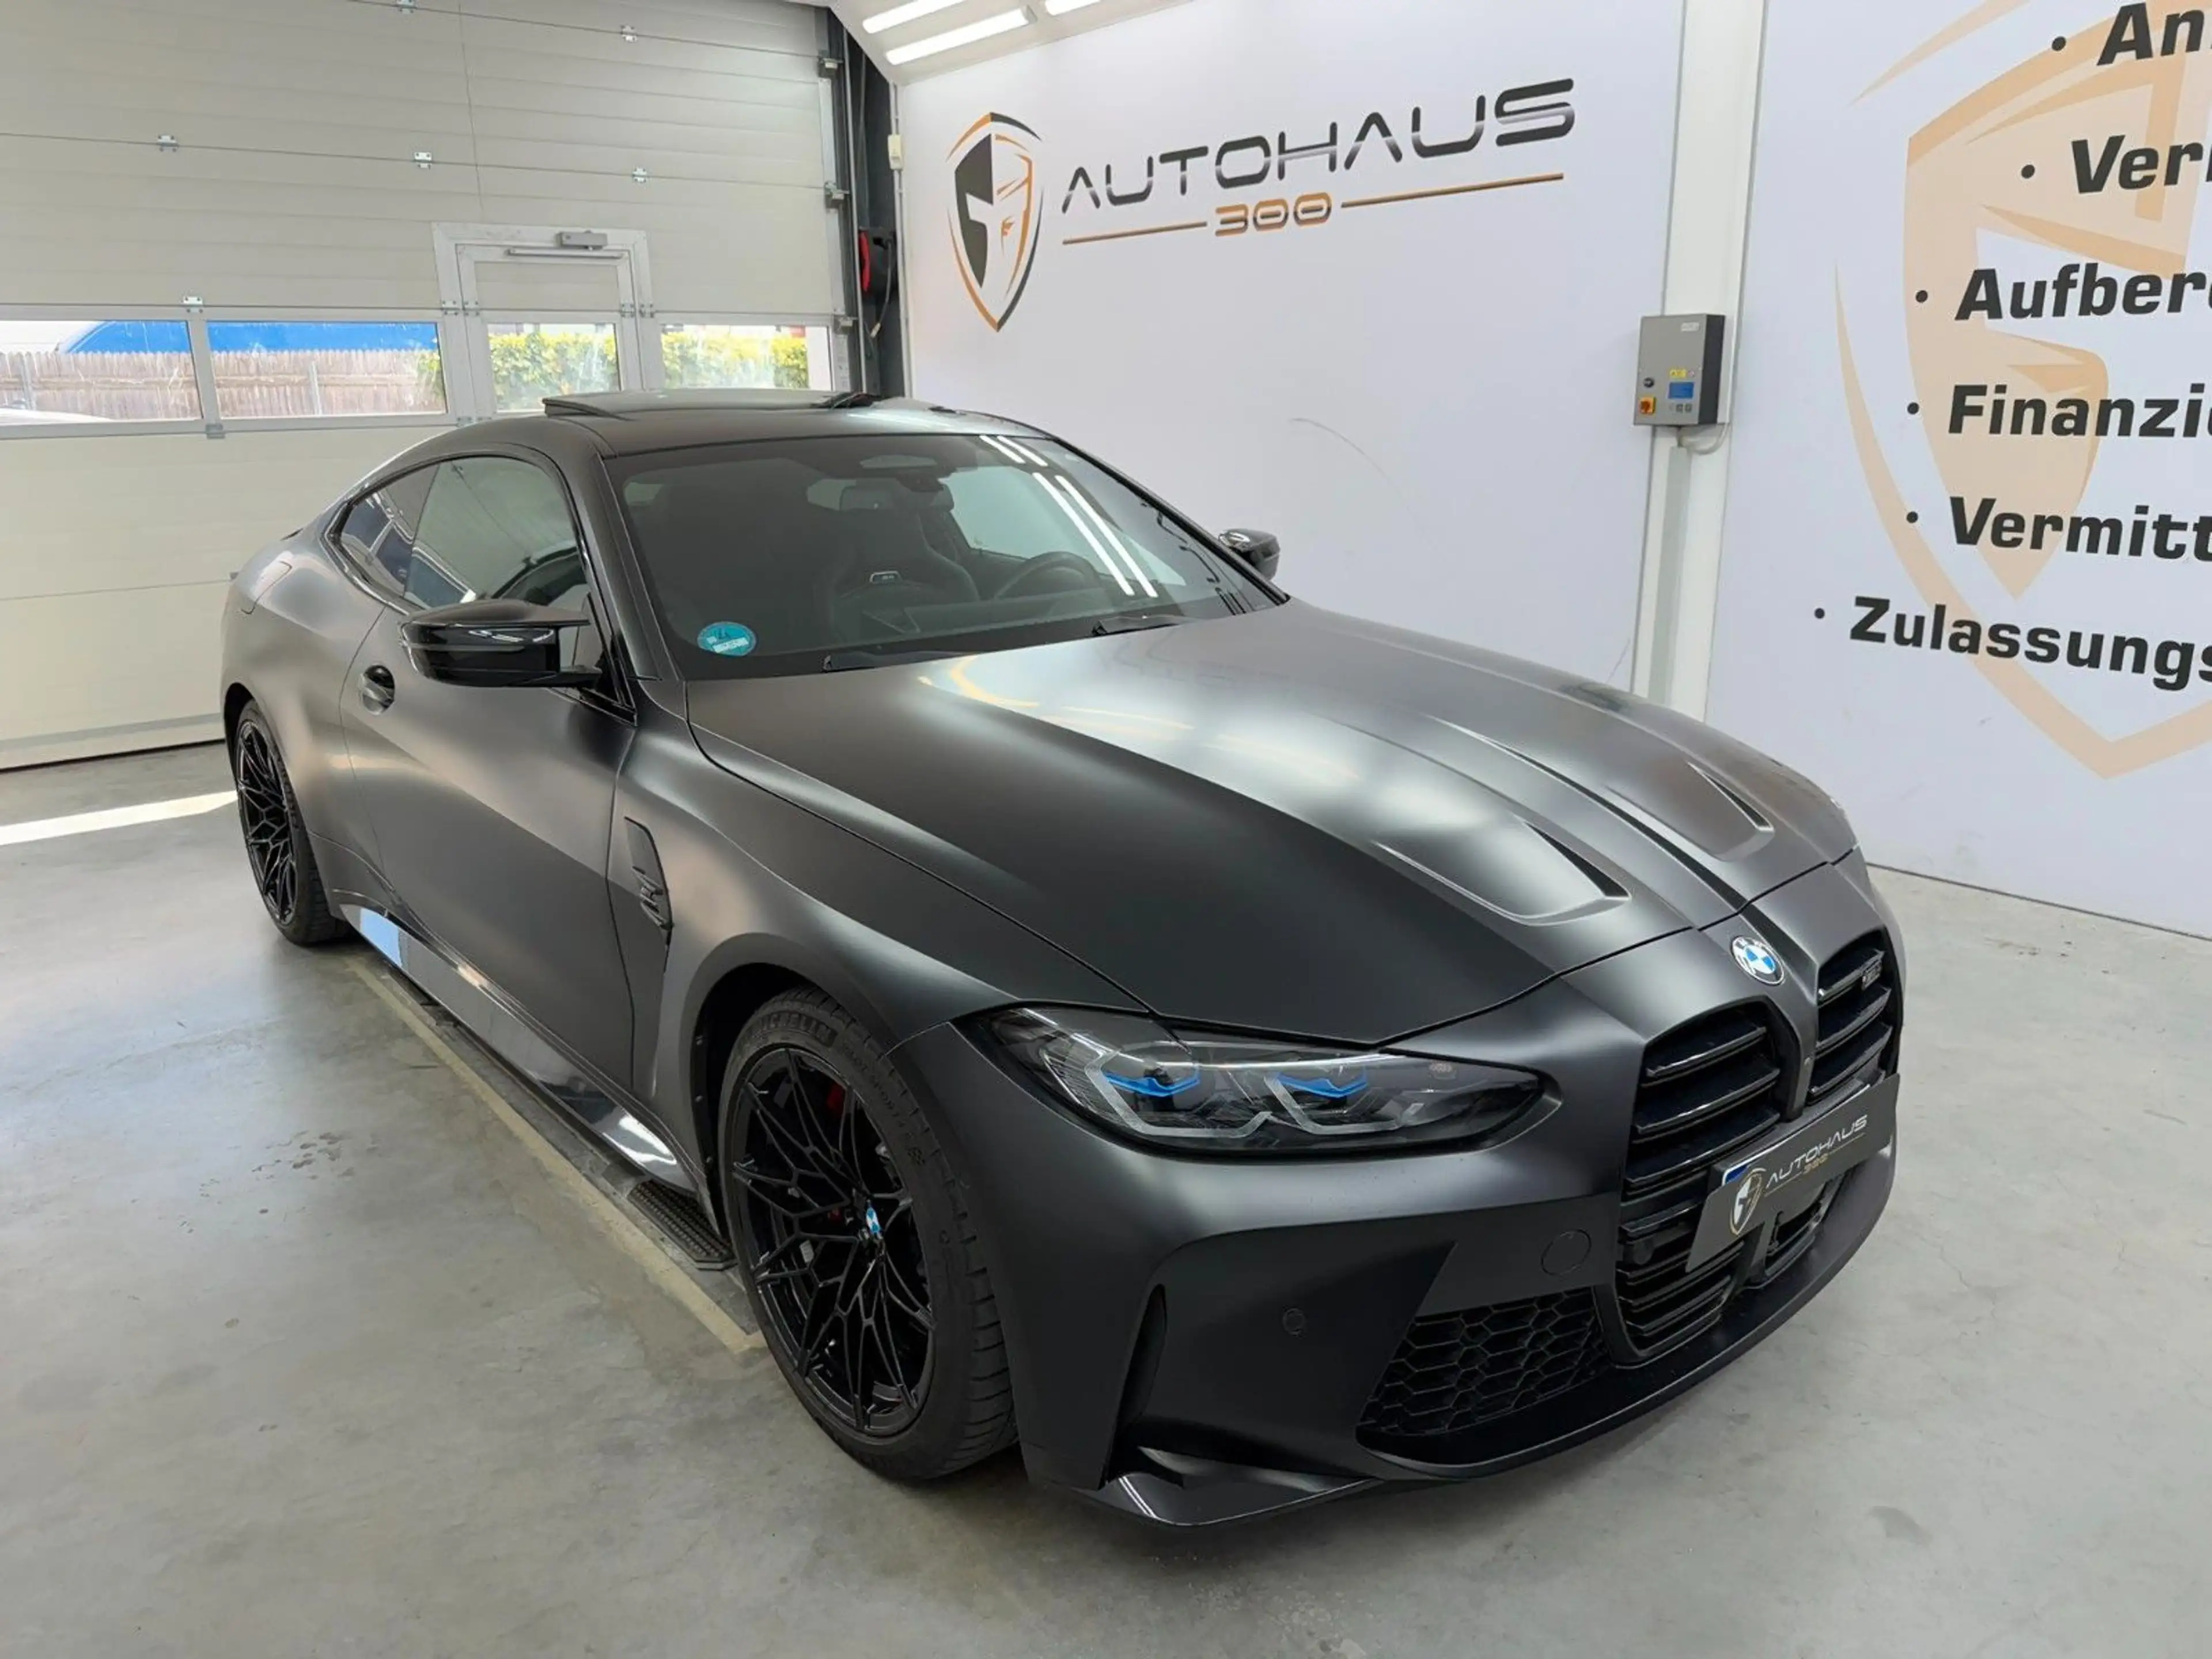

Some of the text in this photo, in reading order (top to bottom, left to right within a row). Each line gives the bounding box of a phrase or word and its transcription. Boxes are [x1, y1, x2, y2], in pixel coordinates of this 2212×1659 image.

[2097, 2, 2212, 66] An
[1061, 78, 1576, 214] AUTOHAUS
[2072, 135, 2212, 194] Ver
[1214, 192, 1332, 237] 300
[1955, 263, 2212, 320] Aufber
[1948, 383, 2212, 438] Finanzi
[1765, 1113, 1868, 1190] AUTOHAUS
